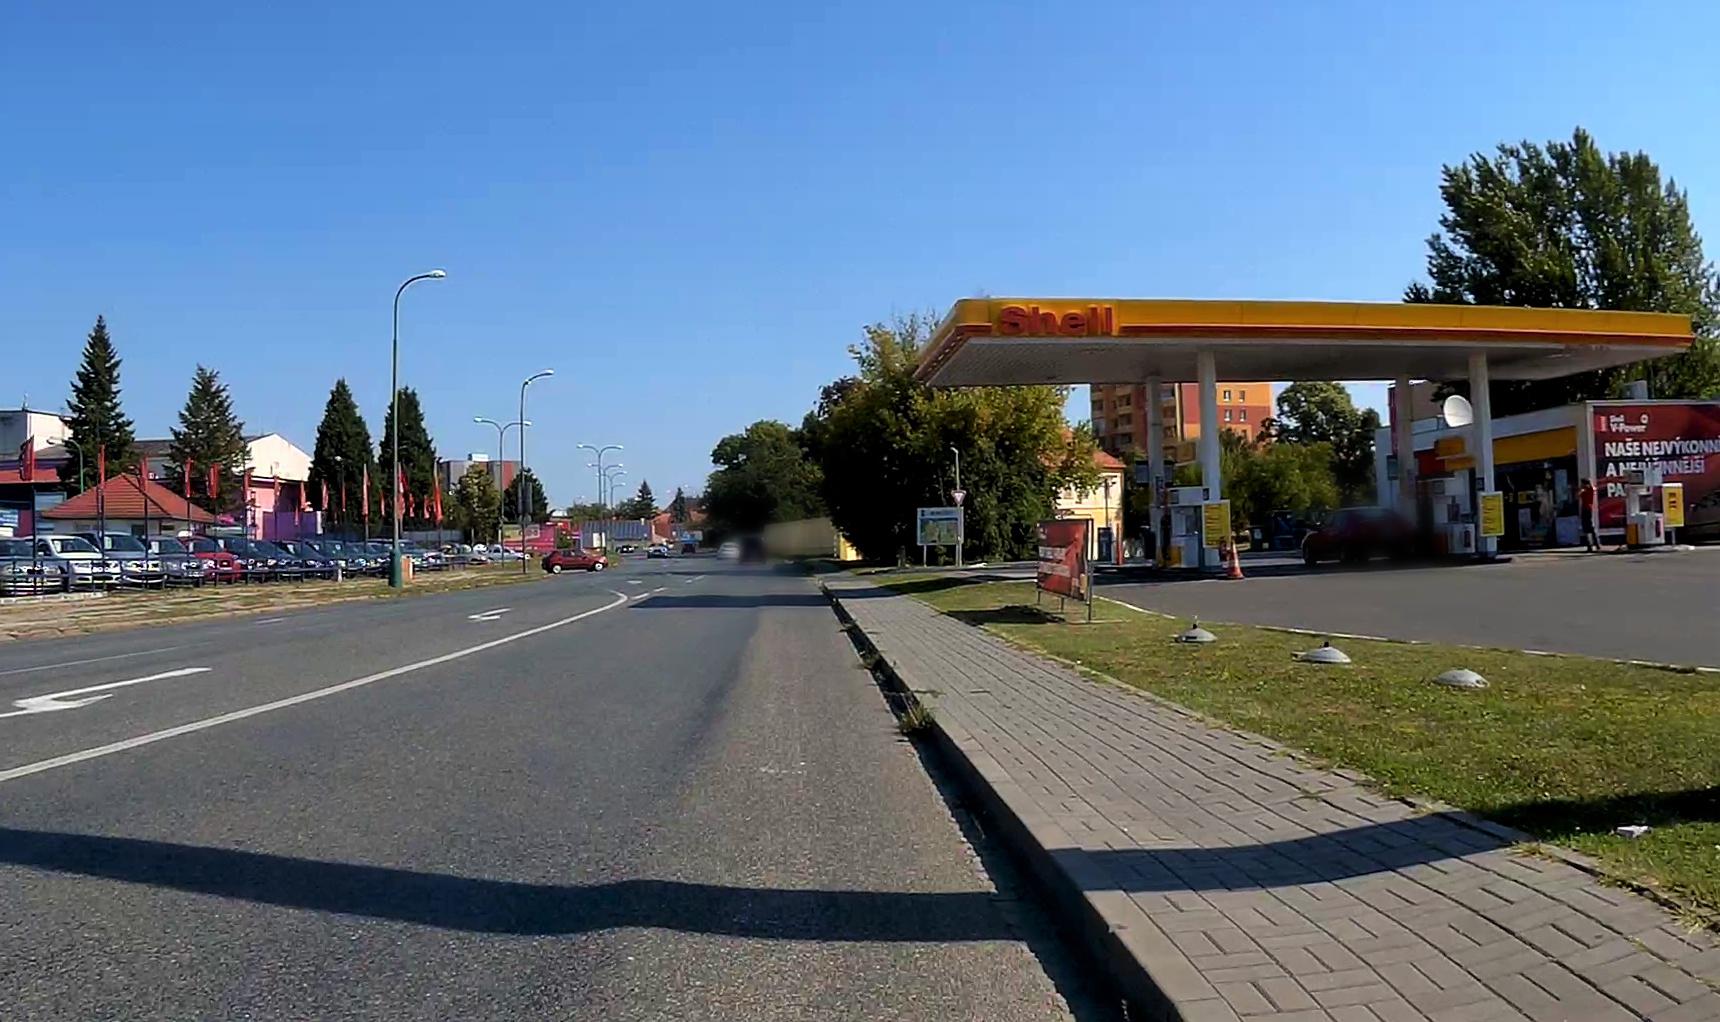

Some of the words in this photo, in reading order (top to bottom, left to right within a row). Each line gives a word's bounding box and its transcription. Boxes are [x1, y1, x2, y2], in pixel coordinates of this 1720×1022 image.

[1000, 305, 1113, 335] Shell
[1604, 438, 1641, 457] NAŠE
[1606, 462, 1617, 477] A
